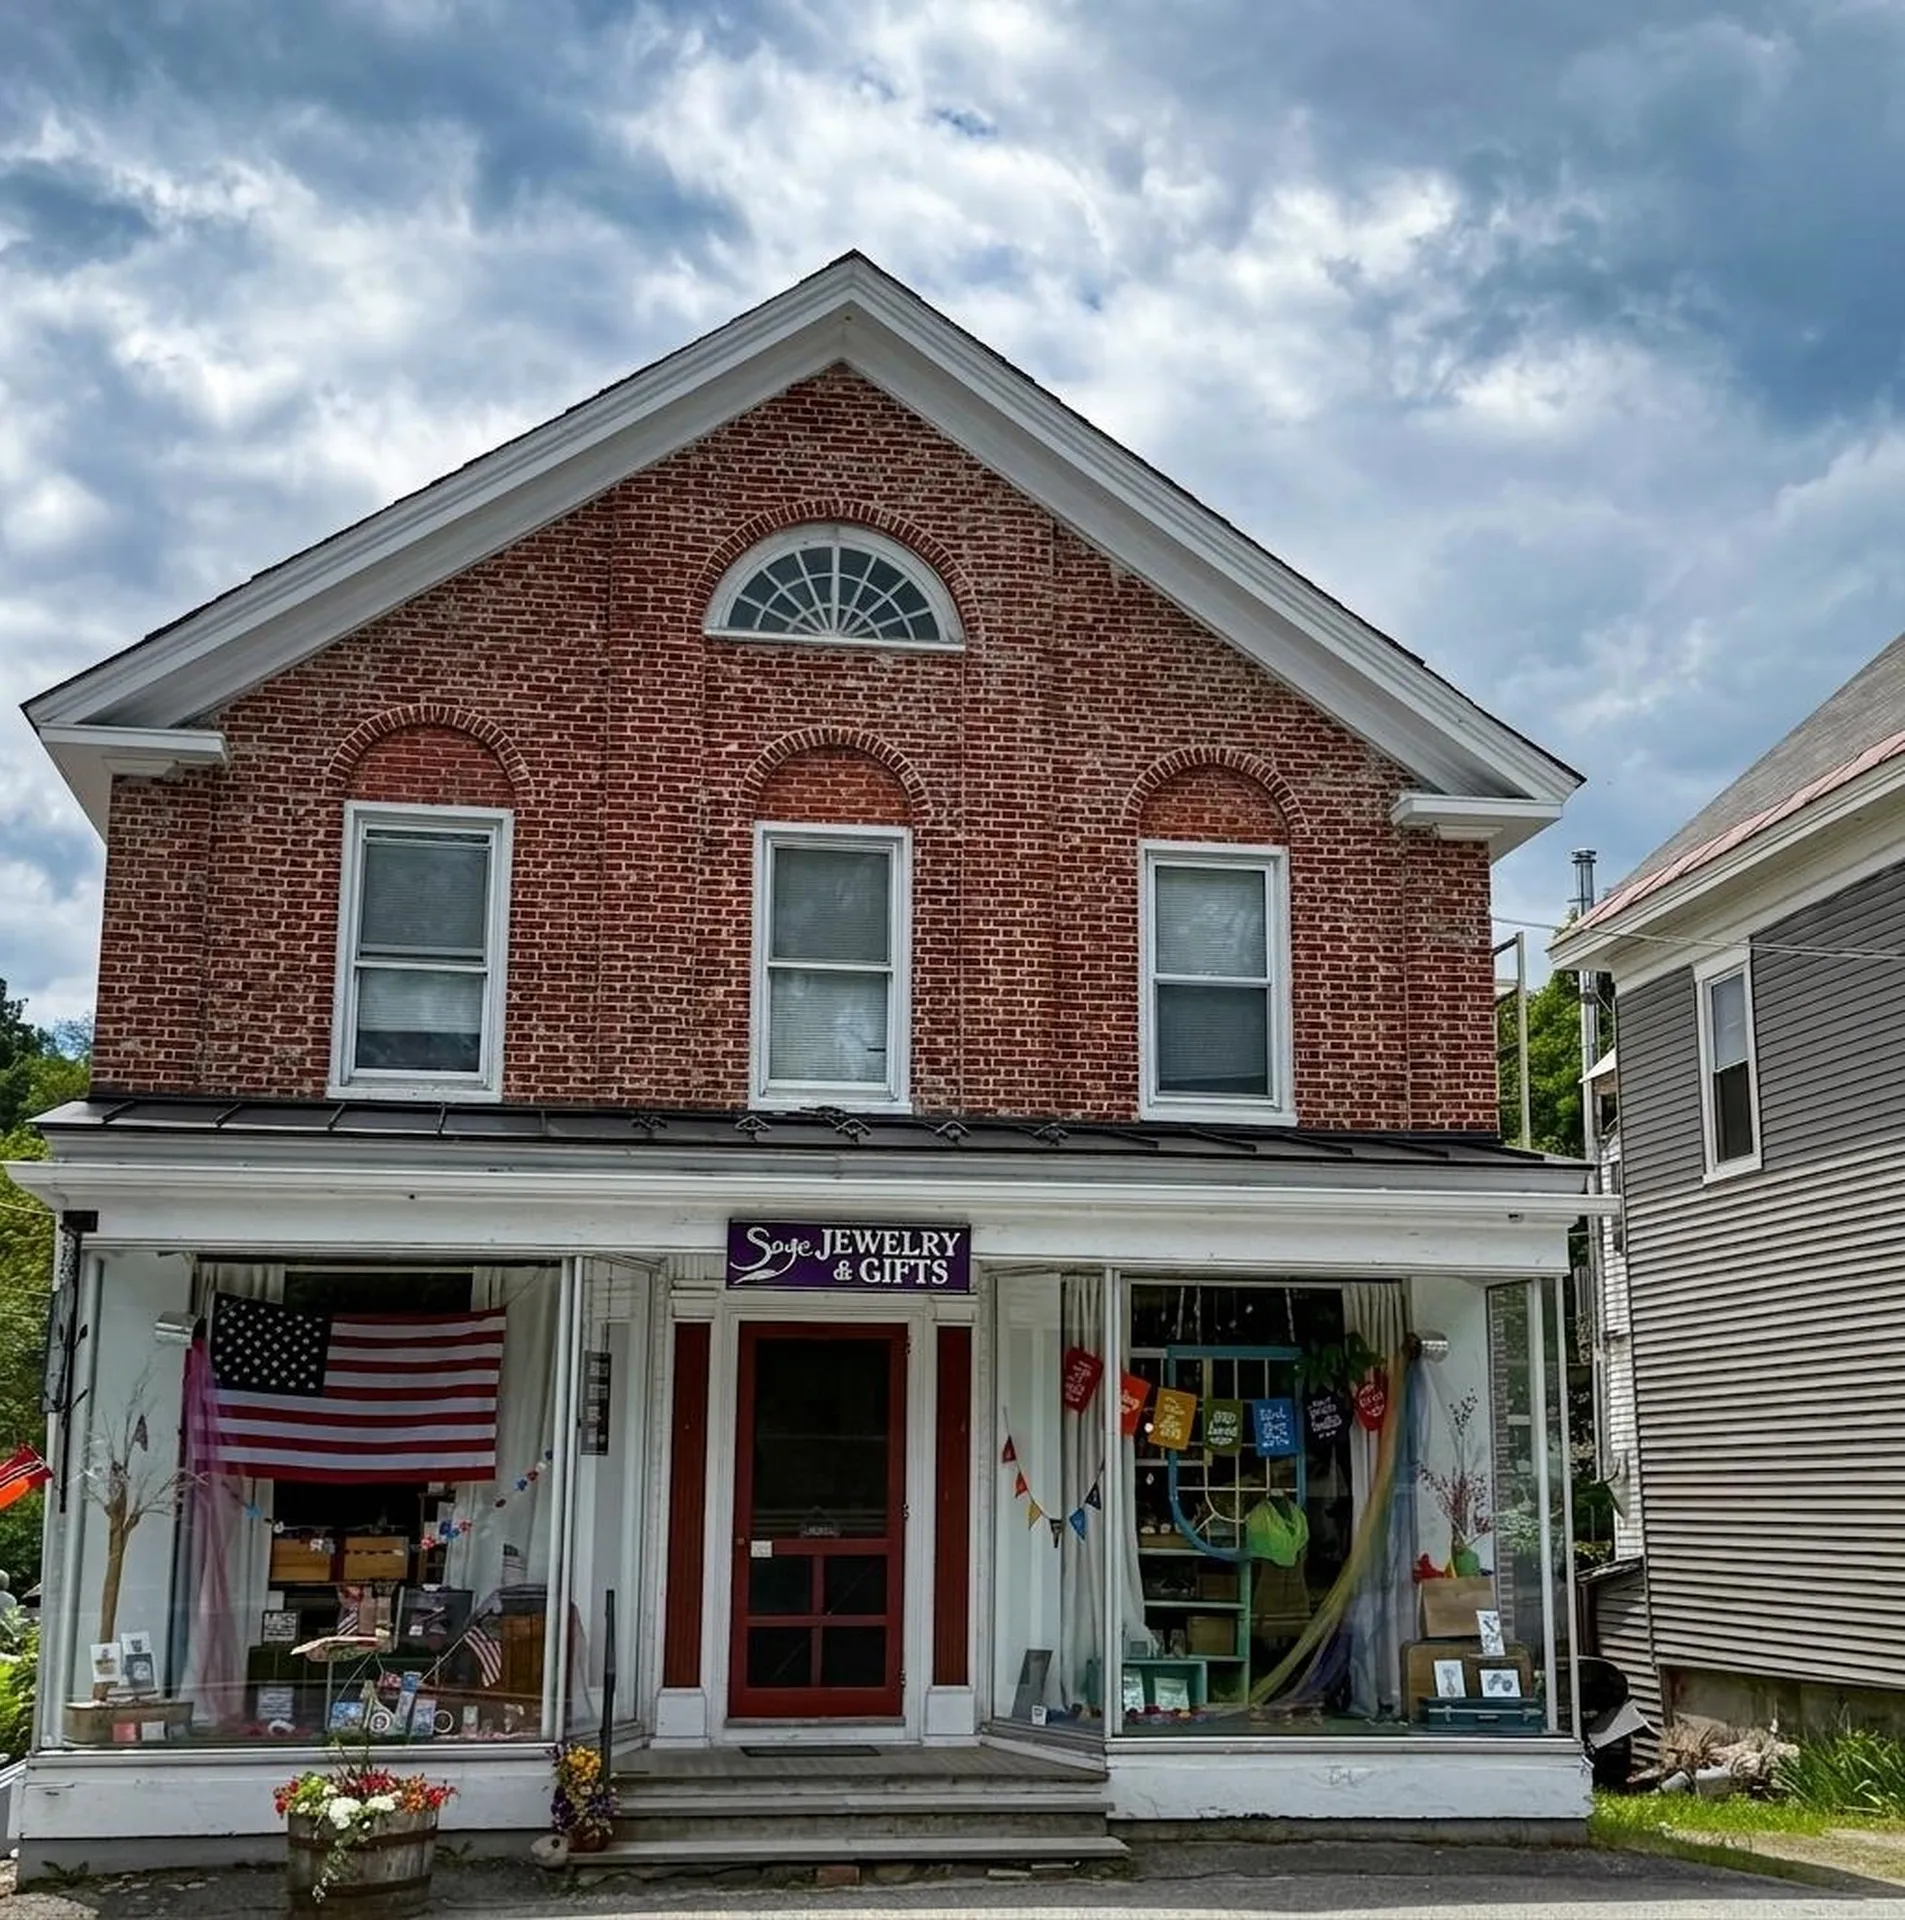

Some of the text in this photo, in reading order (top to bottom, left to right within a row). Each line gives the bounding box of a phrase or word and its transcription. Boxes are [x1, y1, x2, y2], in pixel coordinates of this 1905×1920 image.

[815, 1229, 961, 1260] JEWELRY
[833, 1257, 949, 1284] & GIFTS
